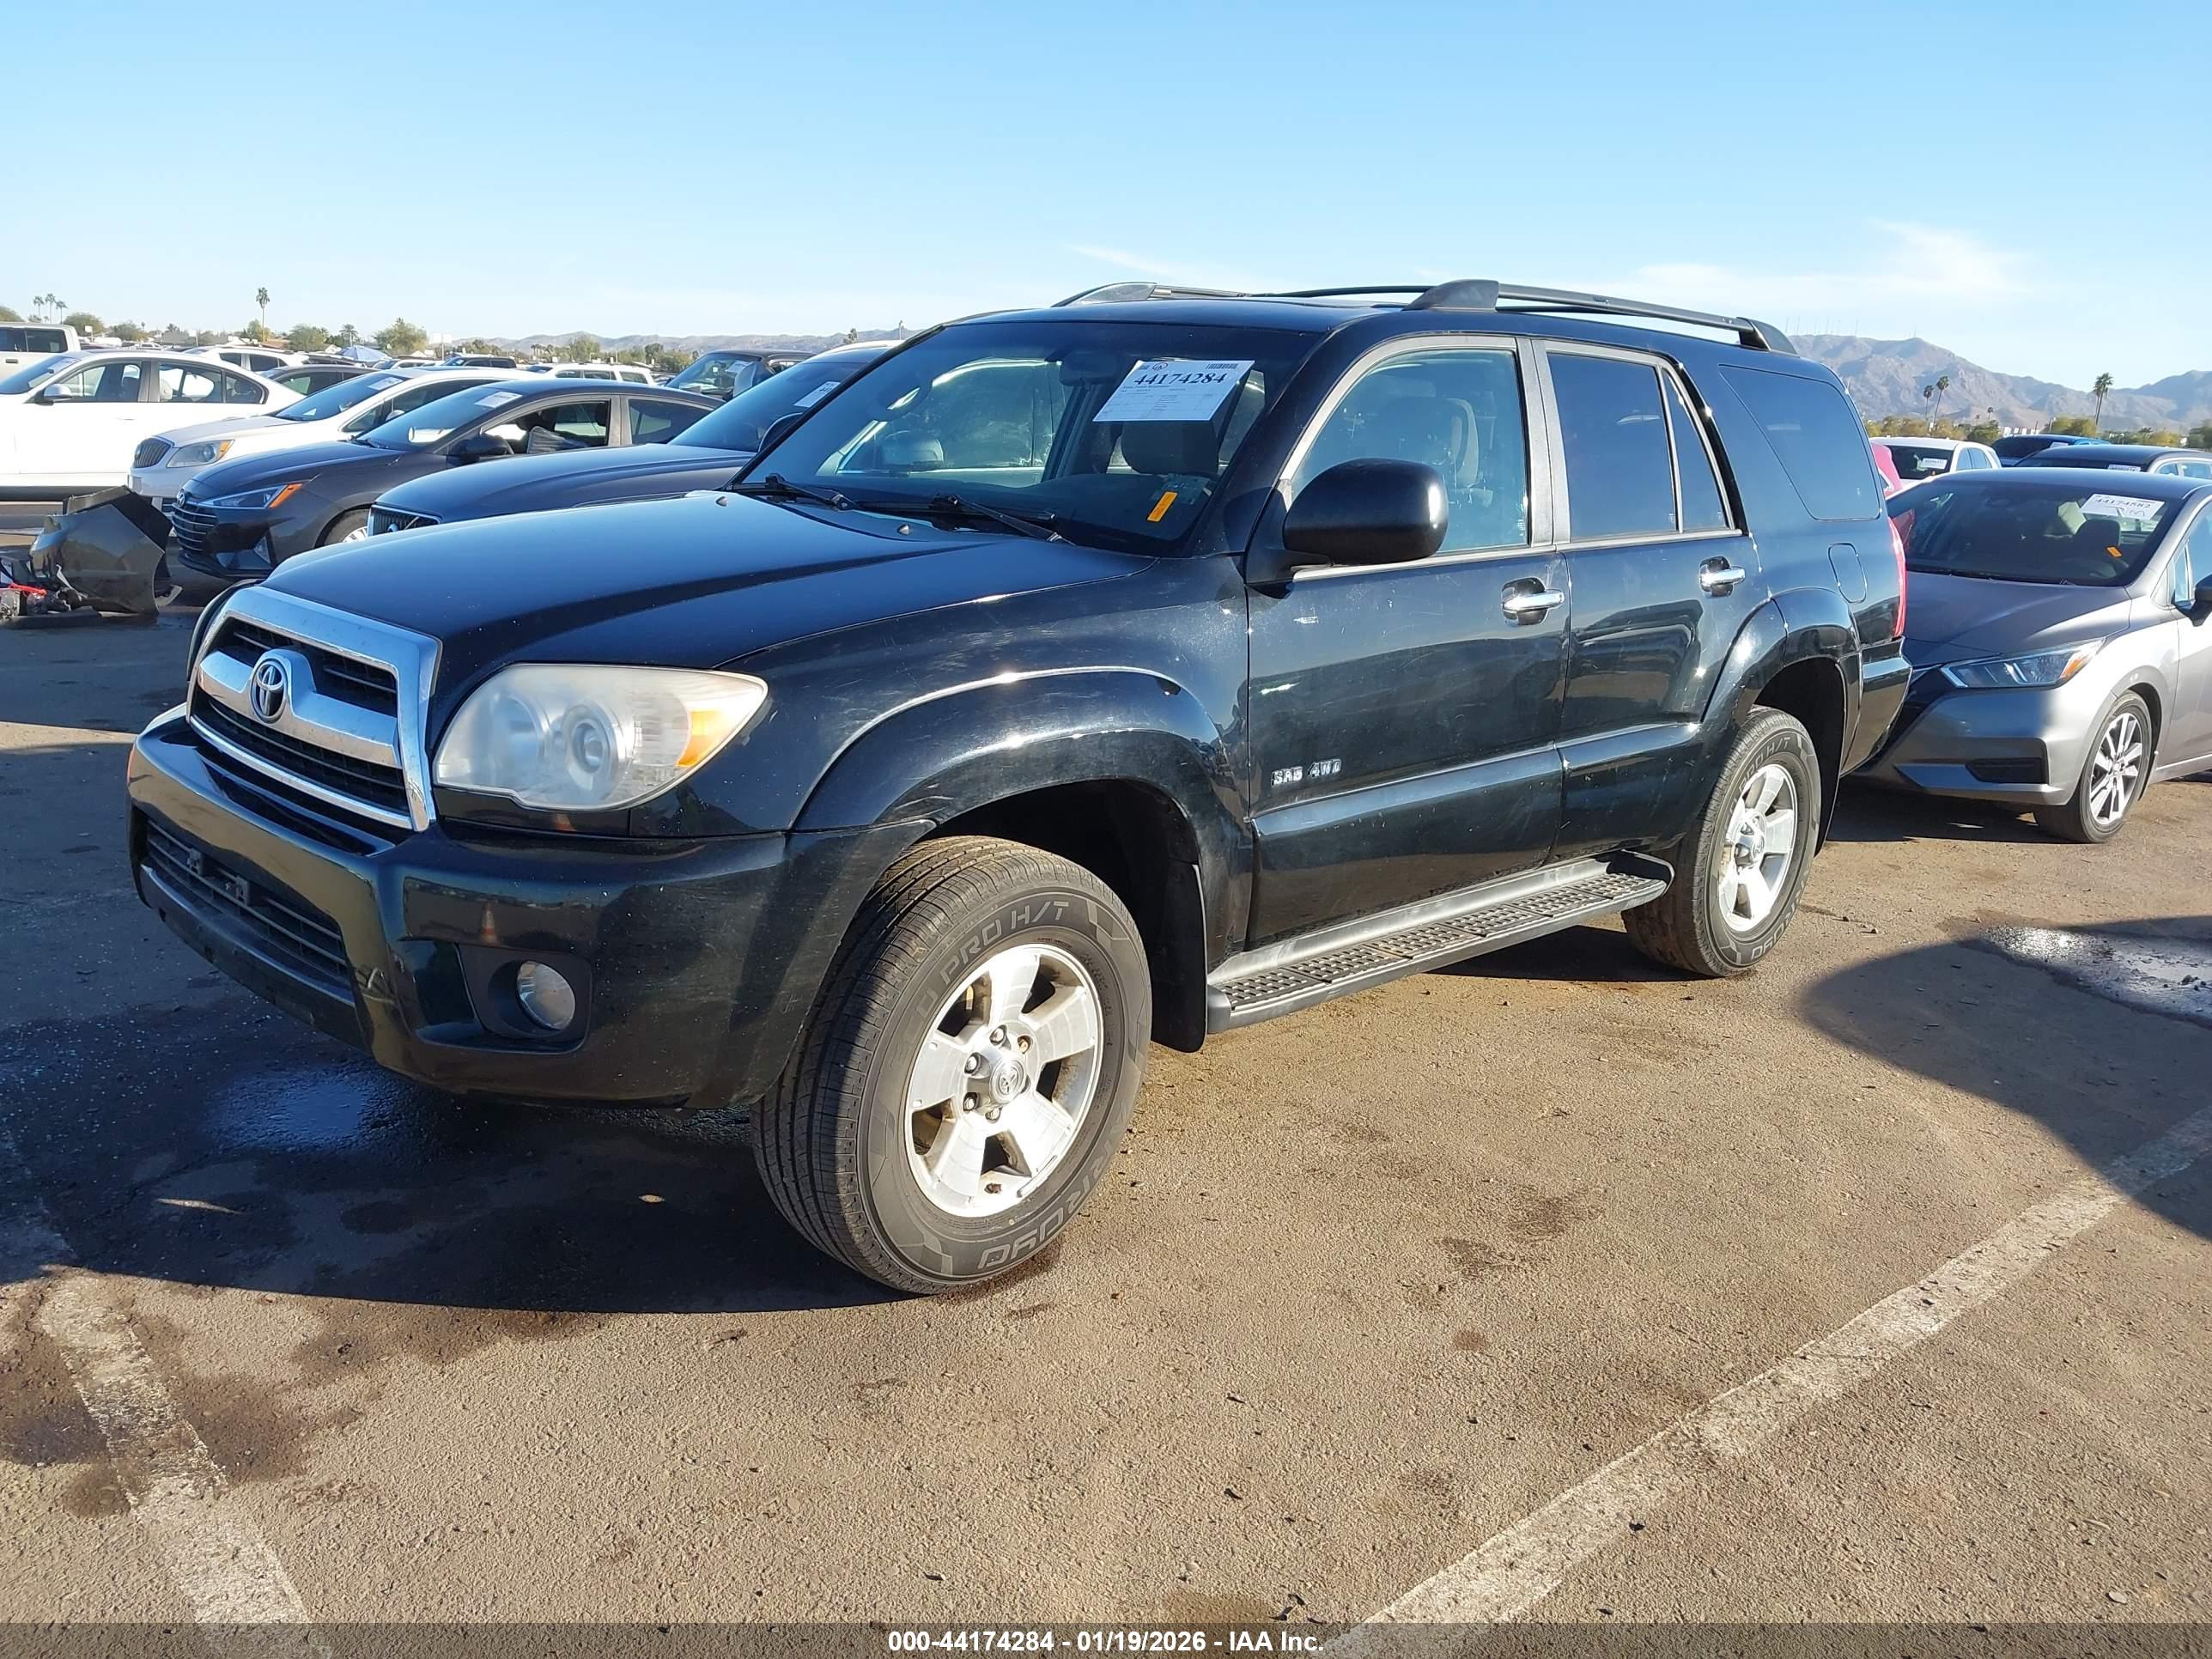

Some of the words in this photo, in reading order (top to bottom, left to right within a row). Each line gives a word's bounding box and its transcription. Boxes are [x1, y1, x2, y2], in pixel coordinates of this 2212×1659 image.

[1133, 372, 1228, 385] 44174284
[1308, 758, 1341, 777] 4WD
[940, 918, 1002, 984] PRO
[1010, 901, 1069, 930] H/T
